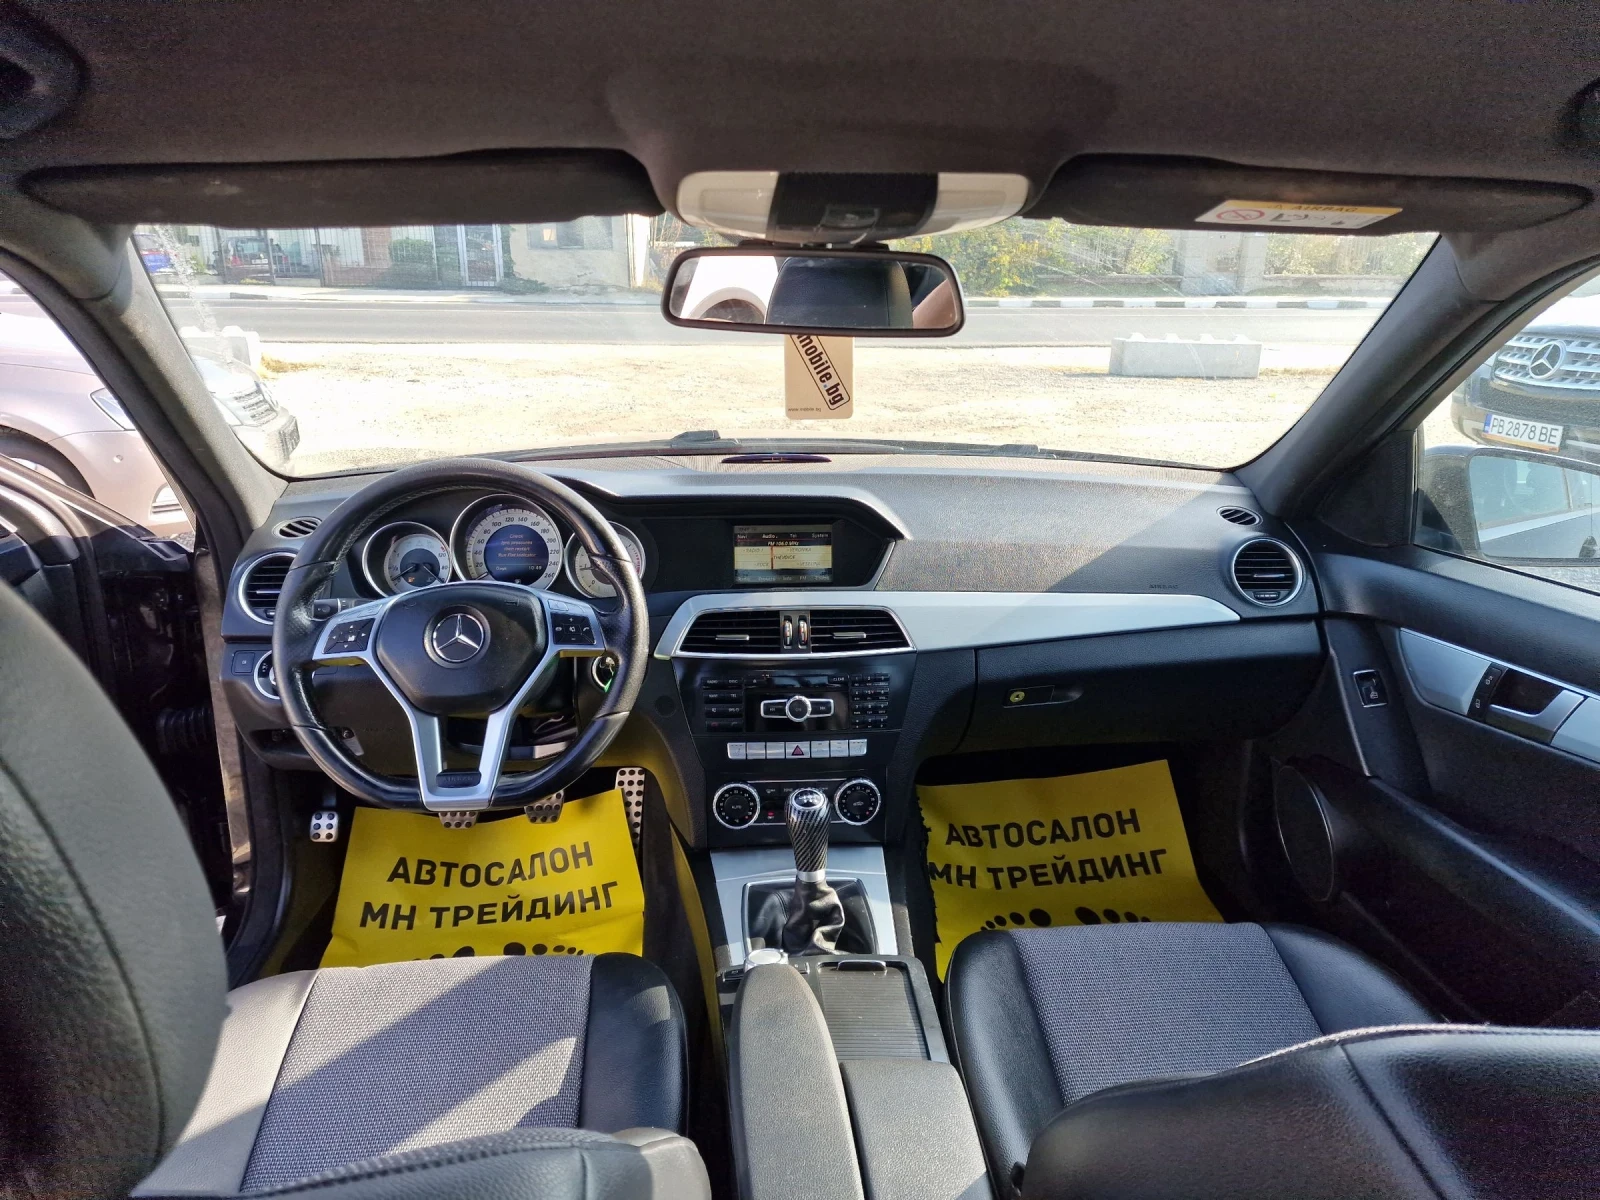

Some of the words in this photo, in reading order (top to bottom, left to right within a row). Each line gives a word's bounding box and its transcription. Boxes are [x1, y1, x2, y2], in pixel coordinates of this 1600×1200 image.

[1491, 417, 1505, 434] PB
[1506, 421, 1537, 440] 2878
[1538, 426, 1559, 444] BE
[945, 808, 1141, 849] АВТОСАЛОН
[387, 841, 594, 888] АВТОСАЛОН
[928, 861, 977, 889] МН
[987, 849, 1167, 890] ТРЕЙДИНГ
[359, 901, 417, 931] МН
[429, 881, 619, 929] ТРЕЙДИНГ
